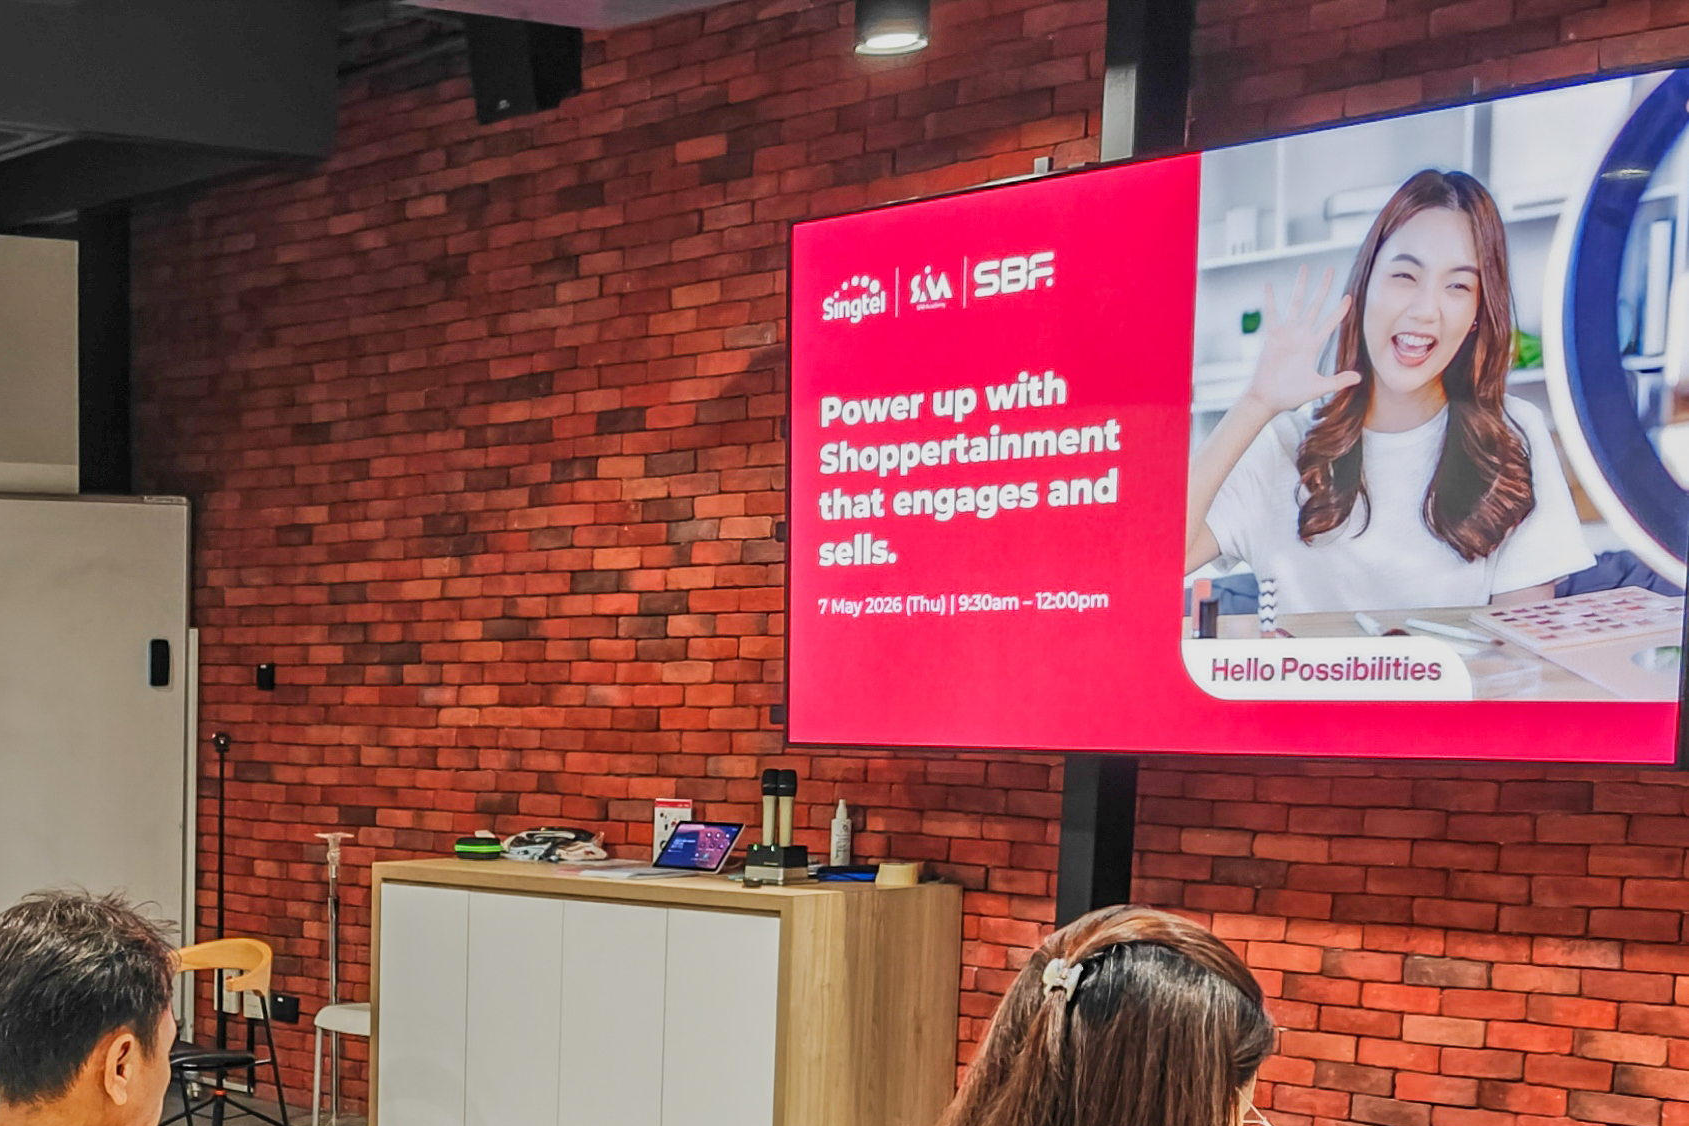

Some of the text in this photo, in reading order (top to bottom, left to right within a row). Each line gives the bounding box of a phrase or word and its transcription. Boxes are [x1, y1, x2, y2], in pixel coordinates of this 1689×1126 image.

[822, 290, 886, 324] Singtel
[820, 370, 1067, 428] Power up with
[819, 419, 1121, 478] Shoppertainment
[818, 467, 1119, 522] that engages and
[818, 533, 897, 567] sells.
[818, 598, 828, 614] 7
[831, 598, 863, 618] May
[865, 596, 903, 614] 2026
[906, 594, 946, 616] (Thu)
[958, 593, 1020, 612] 9:30am
[1036, 590, 1109, 613] 12:00pm
[1211, 656, 1442, 683] Hello Possibilities
